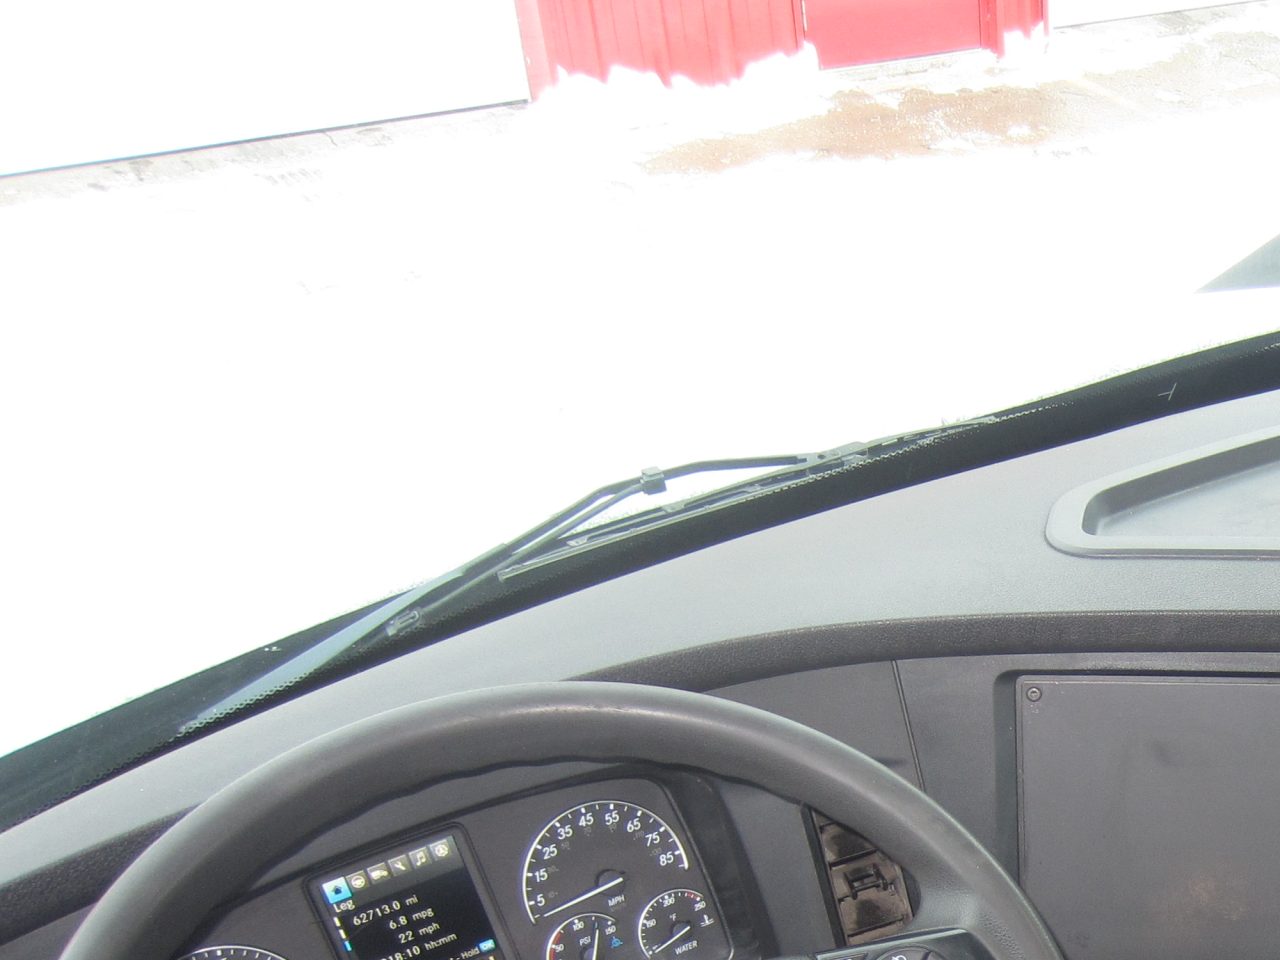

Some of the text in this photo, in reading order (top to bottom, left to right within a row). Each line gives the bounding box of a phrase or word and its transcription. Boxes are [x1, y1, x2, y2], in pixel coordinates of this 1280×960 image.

[578, 812, 594, 827] 45
[604, 810, 620, 826] 55
[626, 818, 641, 833] 65
[557, 825, 573, 840] 35
[645, 832, 660, 847] 75
[542, 844, 558, 860] 25
[659, 852, 674, 867] 85
[534, 868, 548, 883] 15
[333, 898, 355, 913] Leg
[536, 894, 545, 907] 5
[608, 895, 625, 907] MPH
[662, 897, 675, 908] 200
[694, 901, 707, 912] 250
[353, 894, 419, 926] 62713.0 mi
[389, 908, 434, 930] 6.8 mpg
[572, 921, 585, 932] 100
[645, 918, 657, 928] 150
[398, 922, 440, 944] 22 mph
[605, 925, 617, 936] 150
[424, 933, 457, 951] hh:mm
[554, 943, 565, 953] 50
[579, 936, 592, 946] PSI
[674, 940, 698, 956] WATER
[461, 945, 480, 960] Hold
